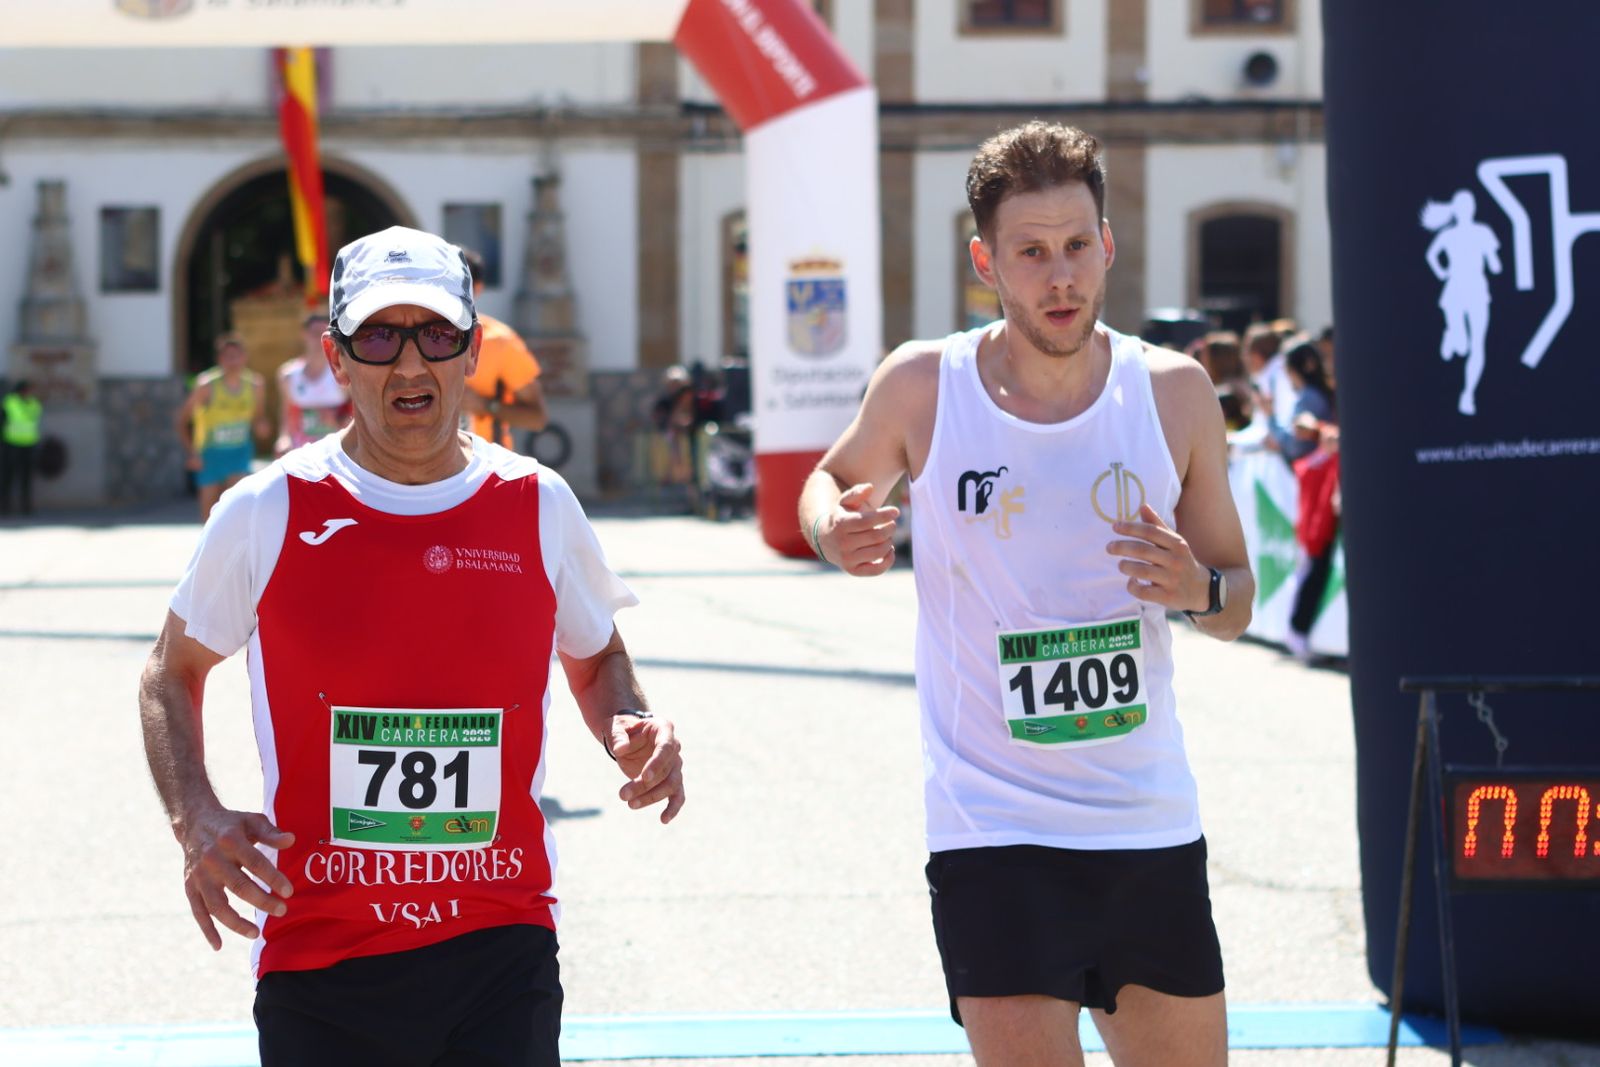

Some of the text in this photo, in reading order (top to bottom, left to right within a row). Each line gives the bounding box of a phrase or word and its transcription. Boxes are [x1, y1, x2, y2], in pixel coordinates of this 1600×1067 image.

[465, 559, 522, 574] SALAMANCA
[1002, 622, 1137, 660] XIV SAN FERNANDO
[1042, 639, 1106, 657] CARRERA
[1009, 653, 1139, 715] 1409
[336, 713, 495, 741] XIV SAN FERNANDO
[381, 728, 459, 742] CARRERA
[358, 749, 470, 809] 781
[304, 847, 524, 887] CORREDORES
